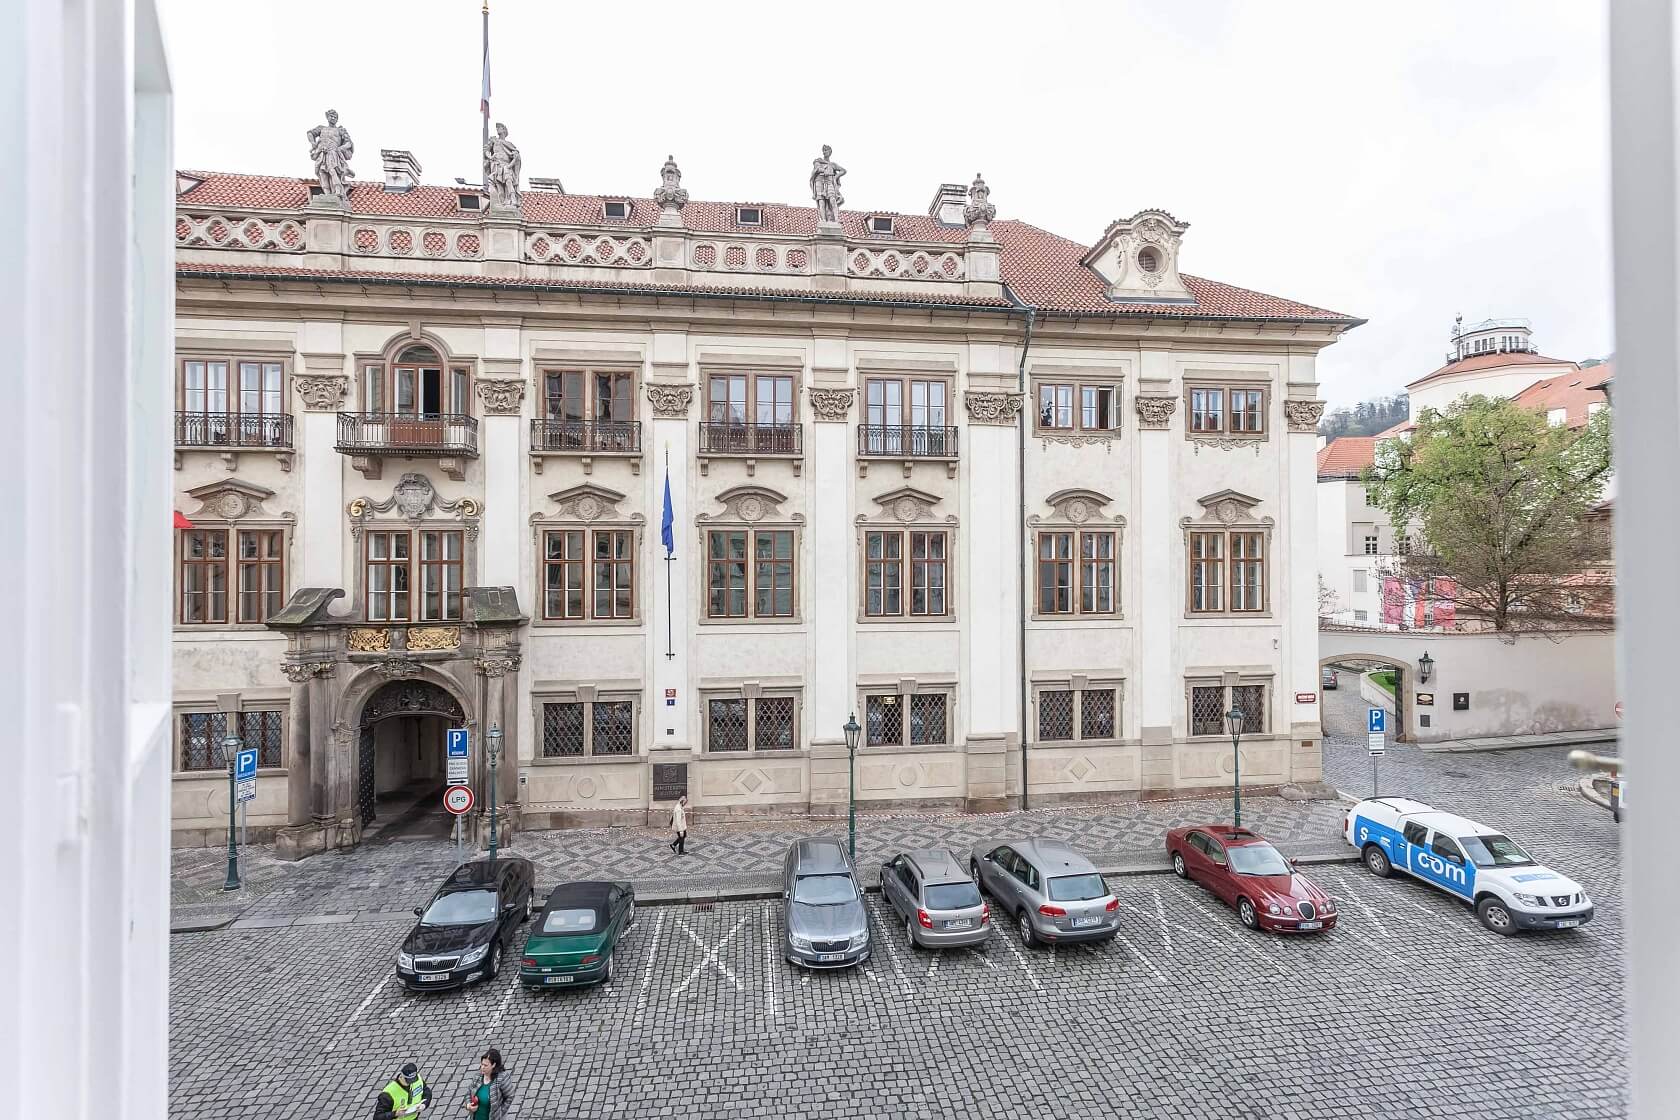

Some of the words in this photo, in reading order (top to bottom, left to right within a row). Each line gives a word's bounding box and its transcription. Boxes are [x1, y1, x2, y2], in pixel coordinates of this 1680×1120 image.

[1372, 710, 1381, 724] P
[452, 732, 461, 748] P
[240, 754, 253, 772] P
[1417, 852, 1466, 885] com
